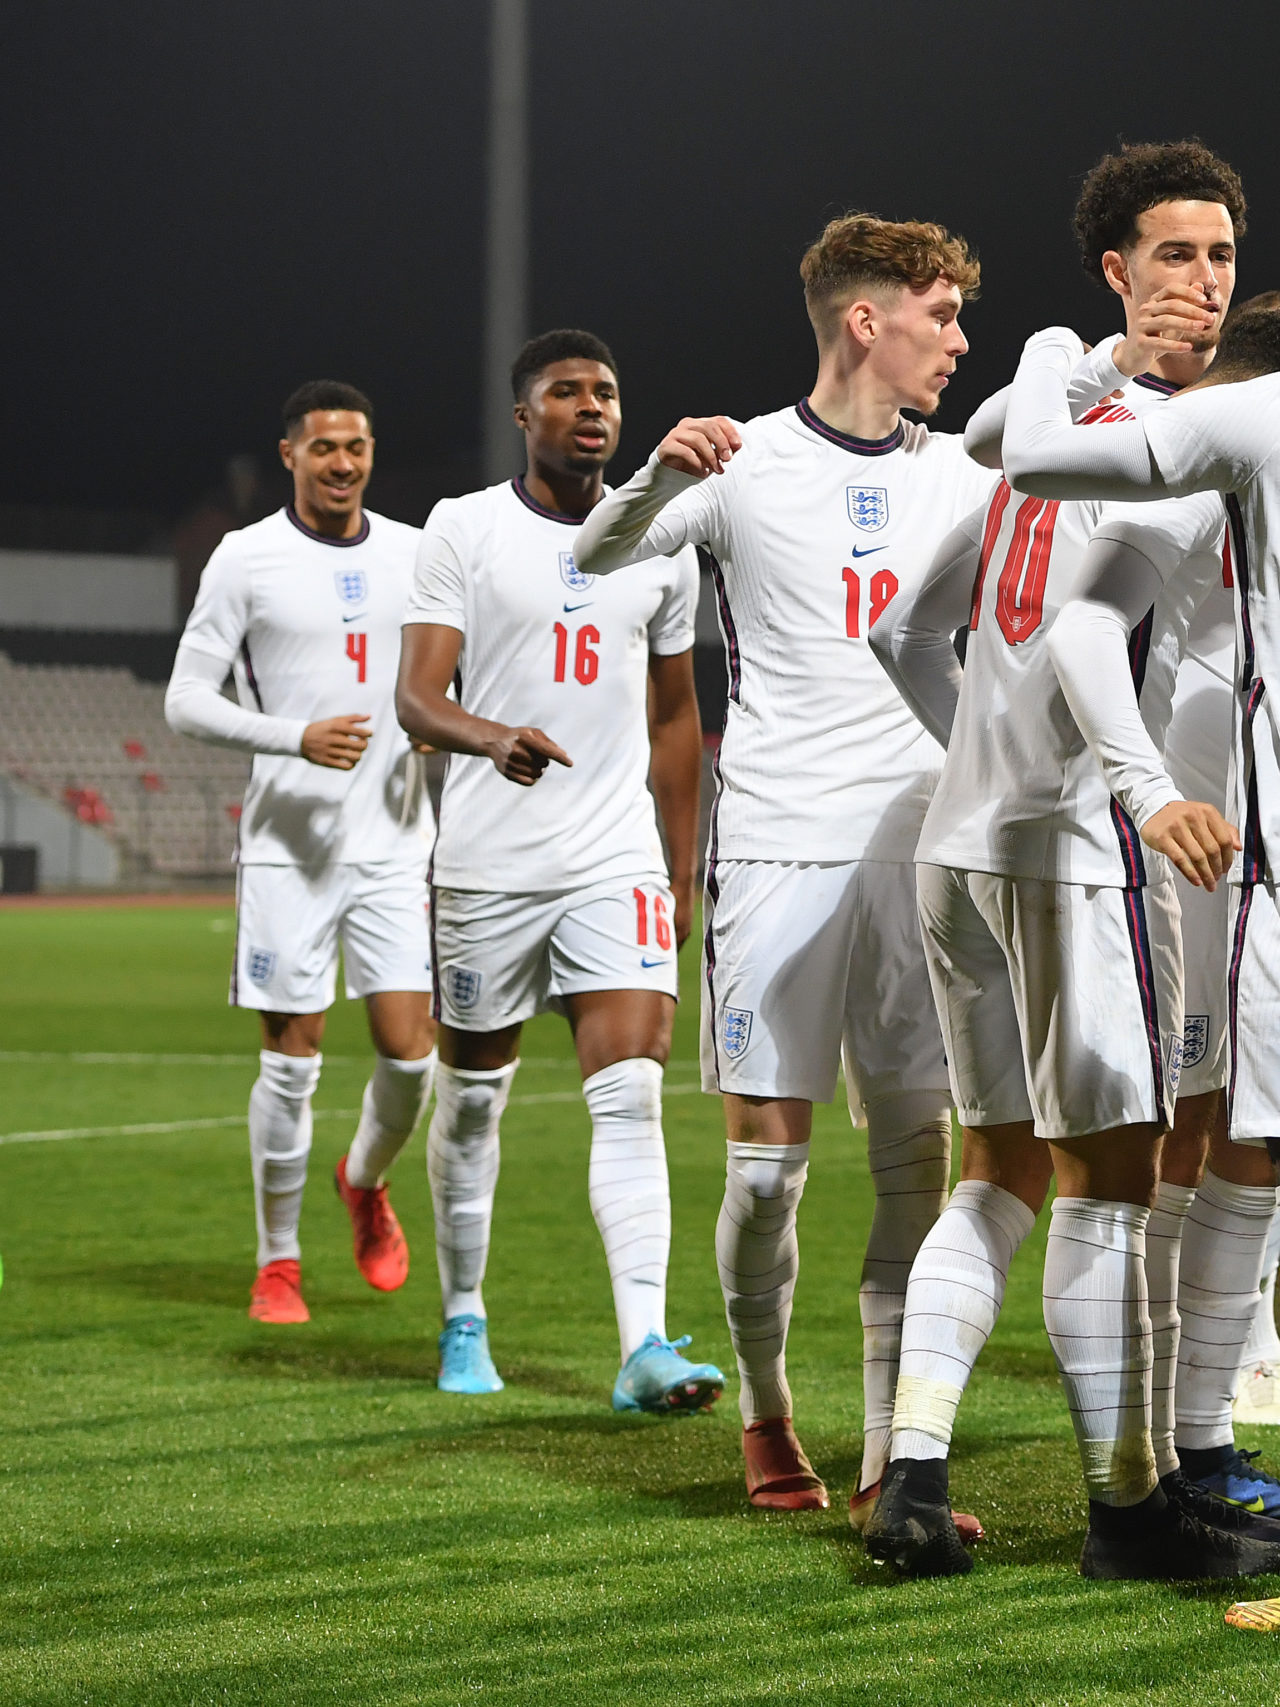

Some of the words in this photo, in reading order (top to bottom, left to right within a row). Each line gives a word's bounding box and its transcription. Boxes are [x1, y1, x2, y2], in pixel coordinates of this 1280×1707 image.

[969, 475, 1061, 646] 10
[842, 567, 899, 638] 18
[346, 633, 367, 683] 4
[553, 622, 600, 686] 16
[633, 886, 671, 951] 16
